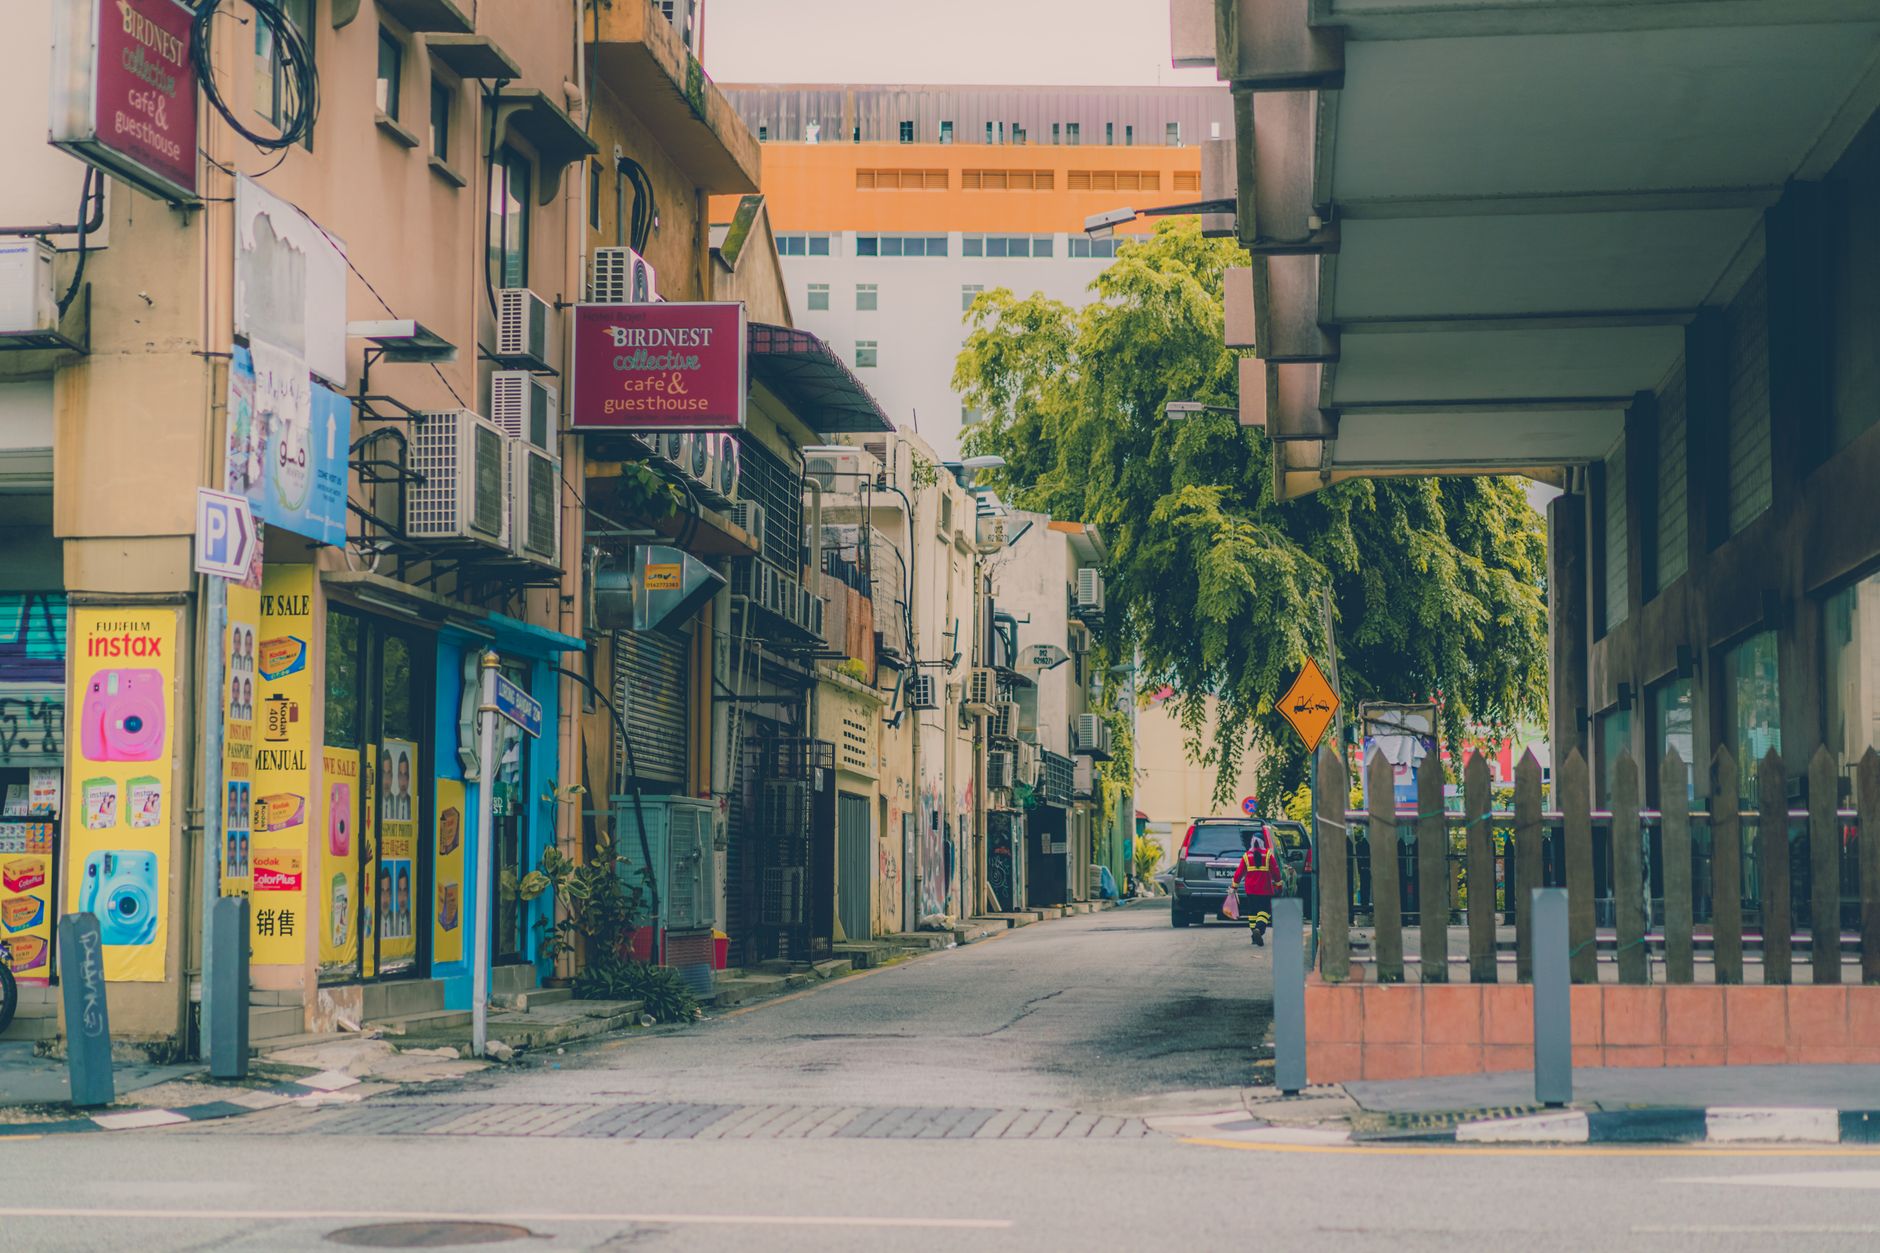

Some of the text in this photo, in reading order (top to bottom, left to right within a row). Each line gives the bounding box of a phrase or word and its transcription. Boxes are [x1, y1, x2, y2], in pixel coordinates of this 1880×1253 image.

[120, 4, 184, 67] BIRDNEST
[154, 95, 168, 130] &
[115, 111, 181, 160] guesthouse
[611, 326, 713, 347] BIRDNEST
[613, 348, 701, 371] collective
[667, 371, 688, 395] &
[604, 395, 709, 414] guesthouse
[207, 507, 226, 556] P
[277, 594, 310, 616] SALE
[96, 621, 151, 632] FUJIFILM
[88, 632, 162, 657] instax
[269, 708, 279, 732] 400
[280, 702, 288, 737] Kodak
[229, 724, 252, 740] INSTANT
[227, 742, 253, 759] PASSPORT
[231, 761, 249, 778] PHOTO
[323, 757, 357, 777] WE SALE
[256, 908, 295, 937] 销售
